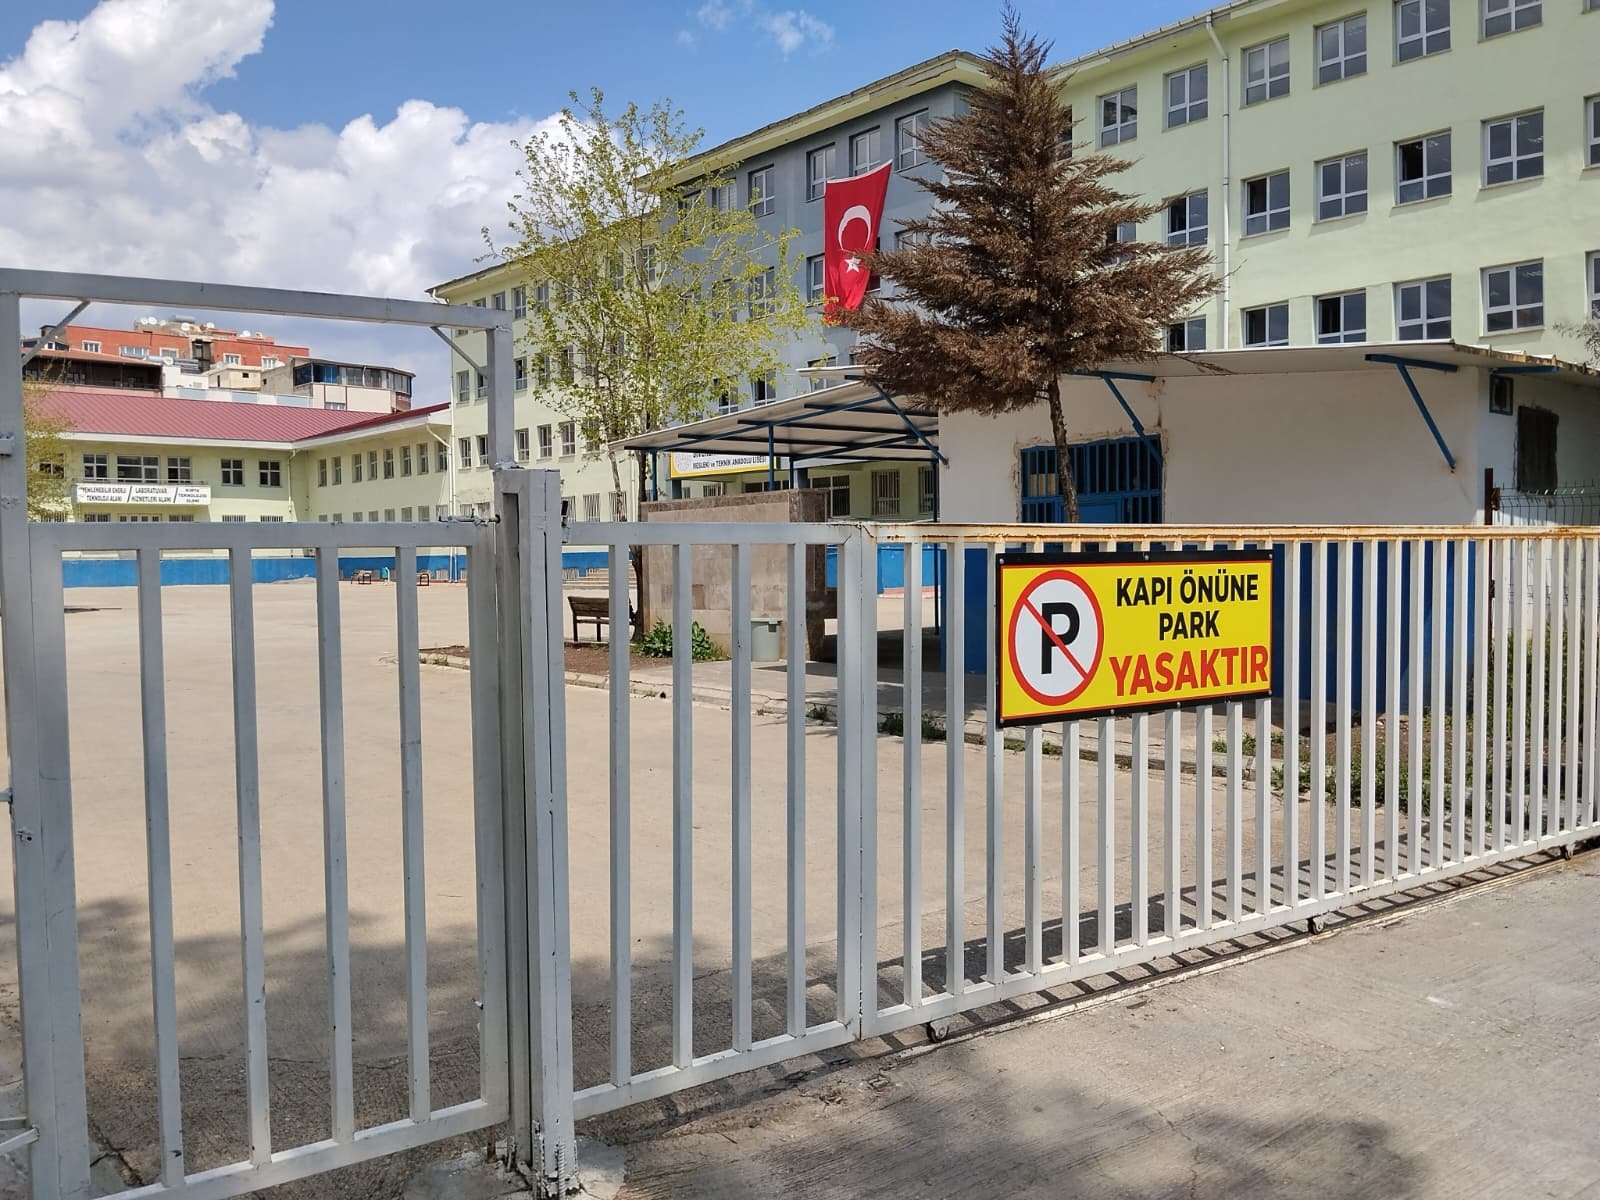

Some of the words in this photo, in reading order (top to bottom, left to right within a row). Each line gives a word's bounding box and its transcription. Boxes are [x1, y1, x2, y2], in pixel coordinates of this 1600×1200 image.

[1116, 576, 1172, 607] KAPI
[1179, 569, 1258, 603] ÖNÜNE
[1041, 602, 1080, 675] P
[1159, 610, 1220, 640] PARK
[1109, 645, 1269, 697] YASAKTIR
